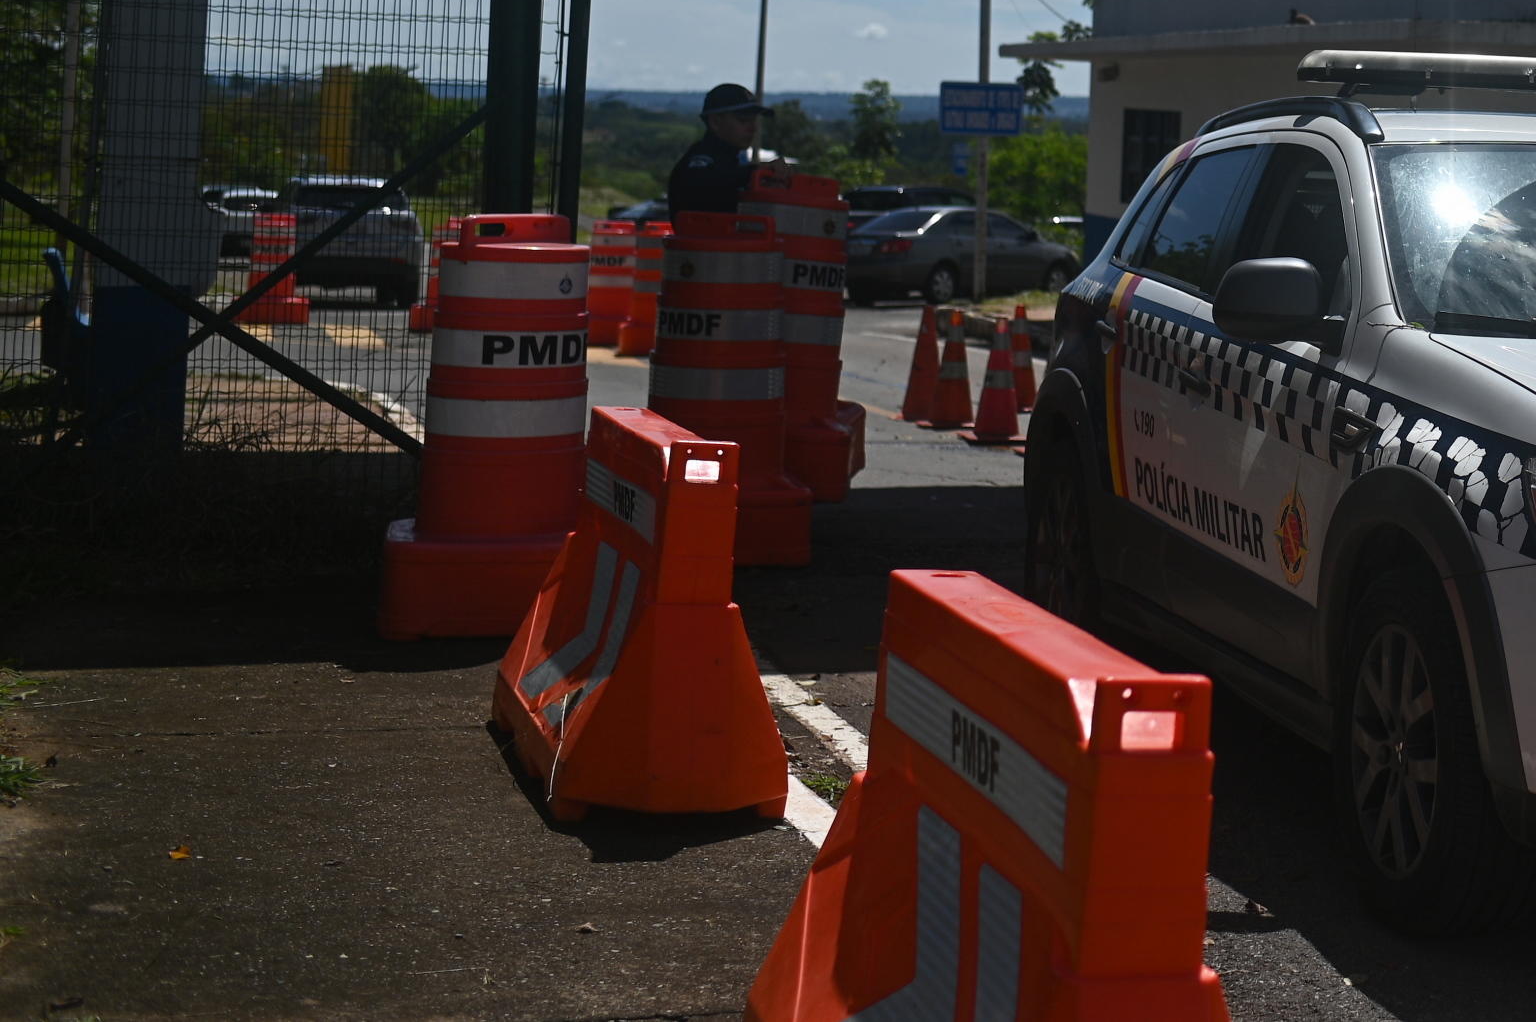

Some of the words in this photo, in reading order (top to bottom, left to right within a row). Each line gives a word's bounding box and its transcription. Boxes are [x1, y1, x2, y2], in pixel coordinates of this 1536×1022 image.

[659, 310, 721, 336] PMDF
[1140, 409, 1155, 438] 190
[1134, 457, 1193, 527] POLÍCIA
[1194, 486, 1266, 563] MILITAR
[952, 708, 999, 794] PMDF
